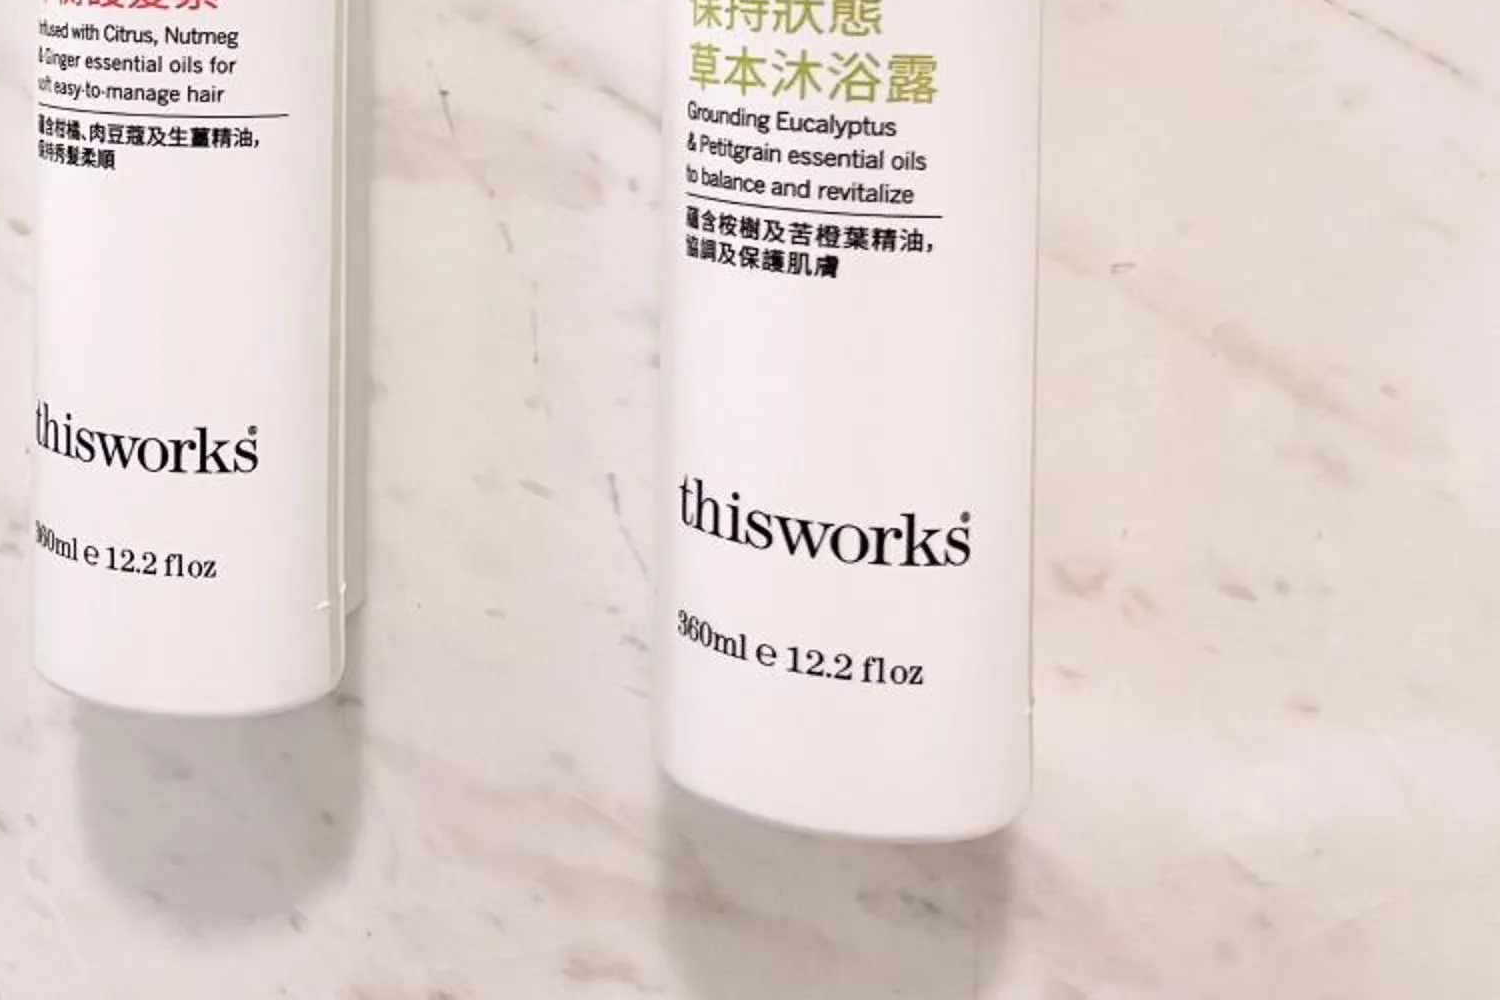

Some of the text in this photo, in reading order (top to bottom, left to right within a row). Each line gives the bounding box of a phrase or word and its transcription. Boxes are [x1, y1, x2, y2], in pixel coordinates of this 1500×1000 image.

[72, 24, 99, 41] with
[103, 24, 158, 47] Citrus,
[165, 27, 239, 49] Nutmeg
[85, 54, 163, 73] essential
[169, 57, 203, 74] oils
[209, 56, 237, 74] for
[689, 42, 938, 104] 草本沐浴露
[54, 80, 181, 106] easy-to-manage
[187, 85, 225, 103] hair
[688, 101, 897, 139] Grounding Eucalyptus
[687, 131, 927, 171] & Petitgrain essential oils
[686, 164, 914, 205] to balance and revitalize
[105, 545, 158, 577] 12.2
[677, 608, 749, 662] 360ml
[785, 645, 854, 682] 12.2
